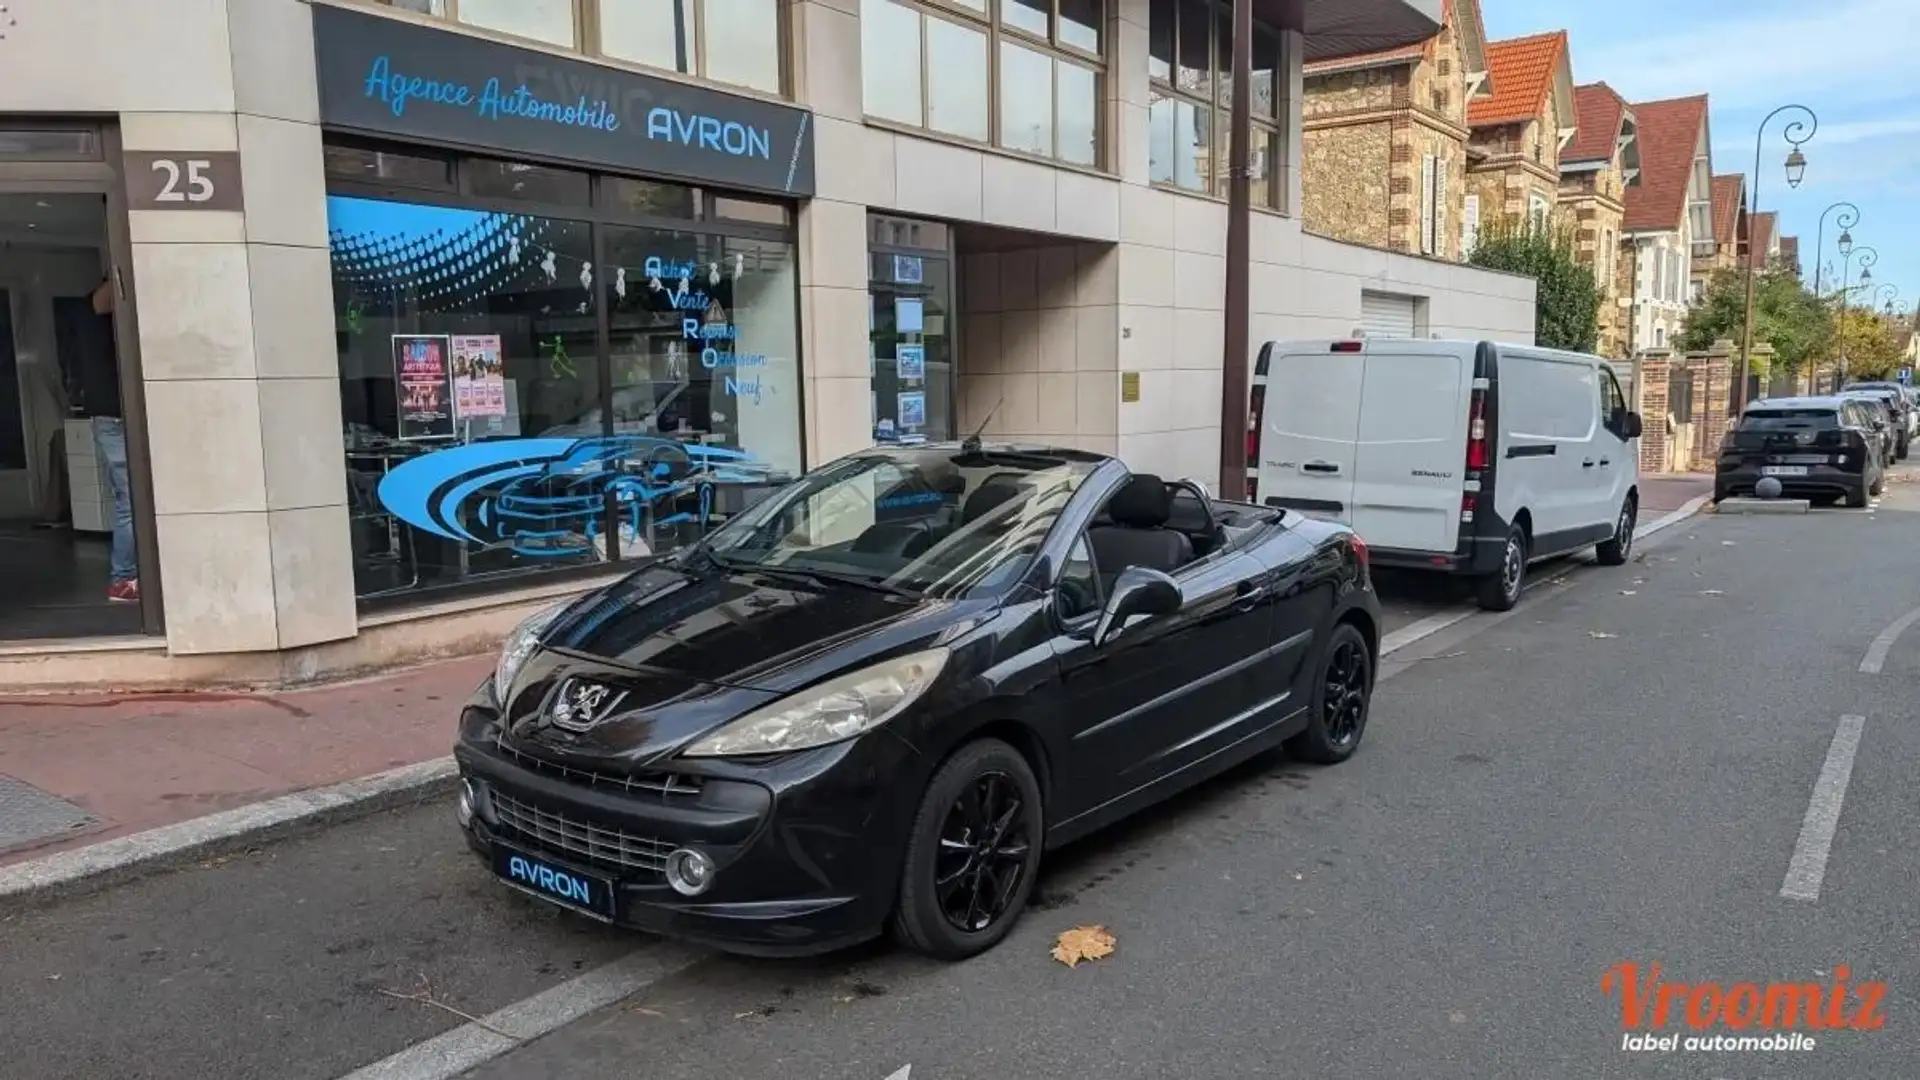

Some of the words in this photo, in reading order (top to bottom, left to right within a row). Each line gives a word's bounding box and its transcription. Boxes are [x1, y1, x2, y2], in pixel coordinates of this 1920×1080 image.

[365, 55, 475, 115] Agence
[478, 76, 620, 132] Automobile
[647, 107, 770, 160] AVRON
[151, 159, 215, 202] 25
[645, 255, 697, 280] Achat
[666, 287, 710, 309] Vente
[724, 375, 762, 406] Neuf
[1411, 468, 1453, 479] RENAULT
[510, 856, 590, 904] AVRON
